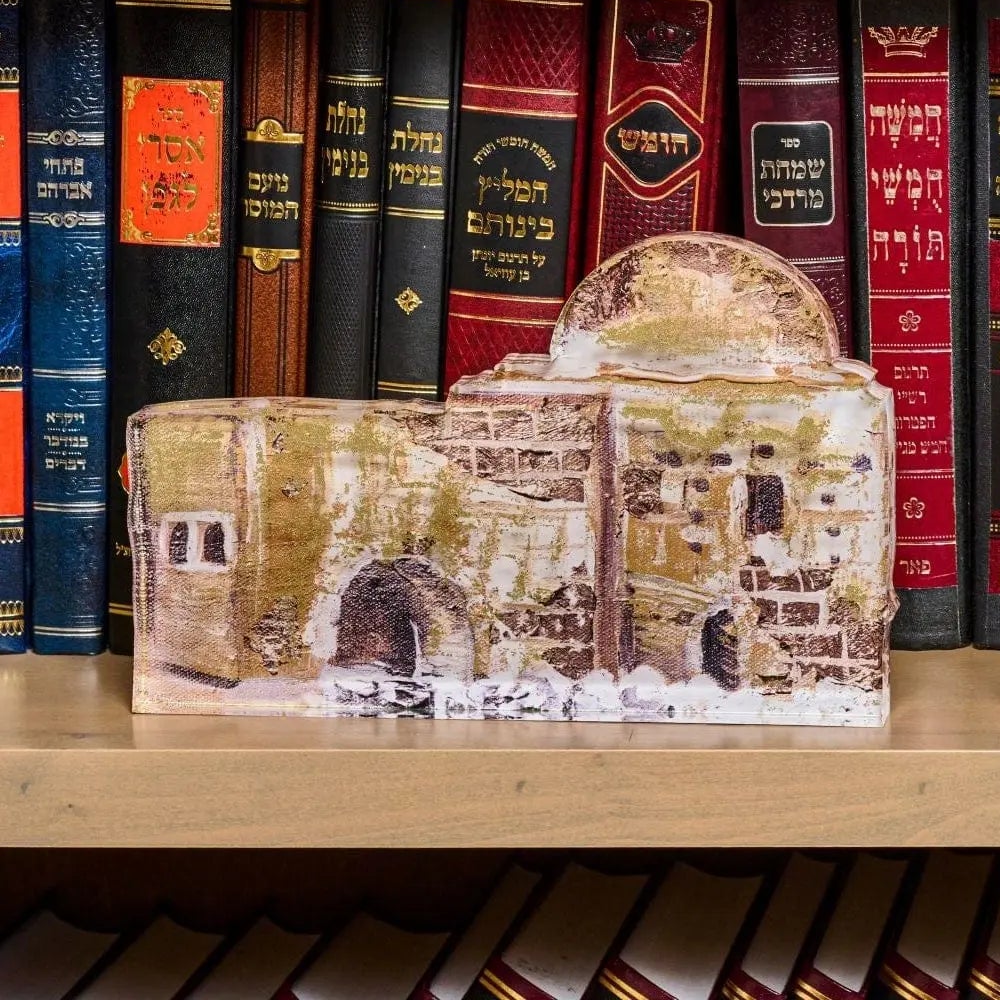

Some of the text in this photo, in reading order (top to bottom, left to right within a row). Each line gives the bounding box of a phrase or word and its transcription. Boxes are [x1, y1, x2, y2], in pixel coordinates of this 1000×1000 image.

[326, 100, 366, 135] נחלת
[391, 120, 443, 154] נחלת
[617, 127, 688, 155] חומש
[780, 137, 801, 148] ספר
[137, 133, 205, 165] אסרי
[43, 157, 84, 175] פתחי
[321, 147, 369, 184] בנימין
[389, 162, 443, 191] בנימין
[760, 158, 826, 180] שמחת
[37, 182, 93, 200] אברהם
[478, 168, 548, 205] המליץ
[763, 188, 825, 209] מרדכי
[467, 209, 555, 240] בינותם
[46, 412, 85, 426] ויקרא
[44, 435, 89, 447] במדבר
[45, 458, 86, 471] דברים
[900, 558, 931, 575] פאר
